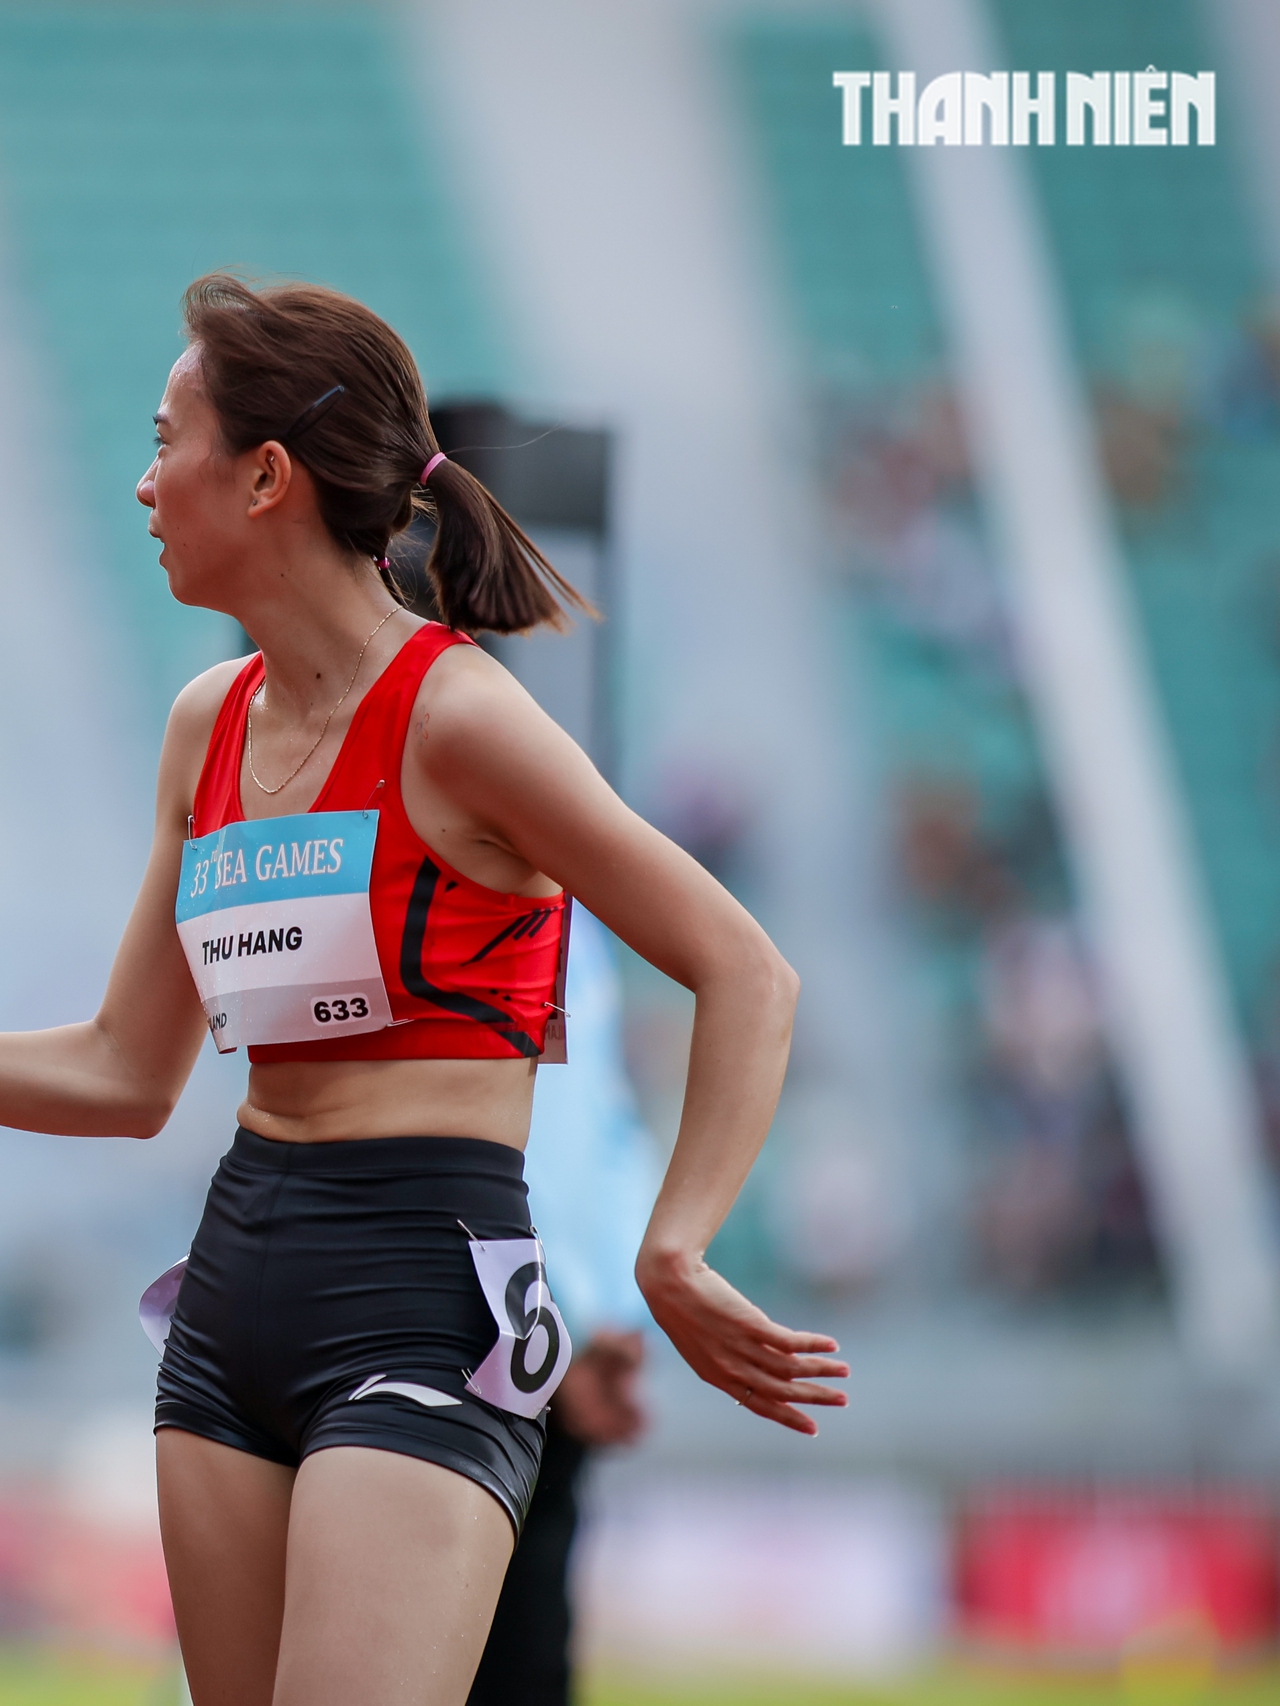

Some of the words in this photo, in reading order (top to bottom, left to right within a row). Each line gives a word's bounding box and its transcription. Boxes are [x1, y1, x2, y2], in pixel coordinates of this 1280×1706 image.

[214, 848, 248, 890] SEA
[255, 838, 344, 882] GAMES
[202, 935, 234, 966] THU
[237, 926, 303, 957] HANG
[313, 997, 369, 1023] 633
[504, 1261, 560, 1394] 6
